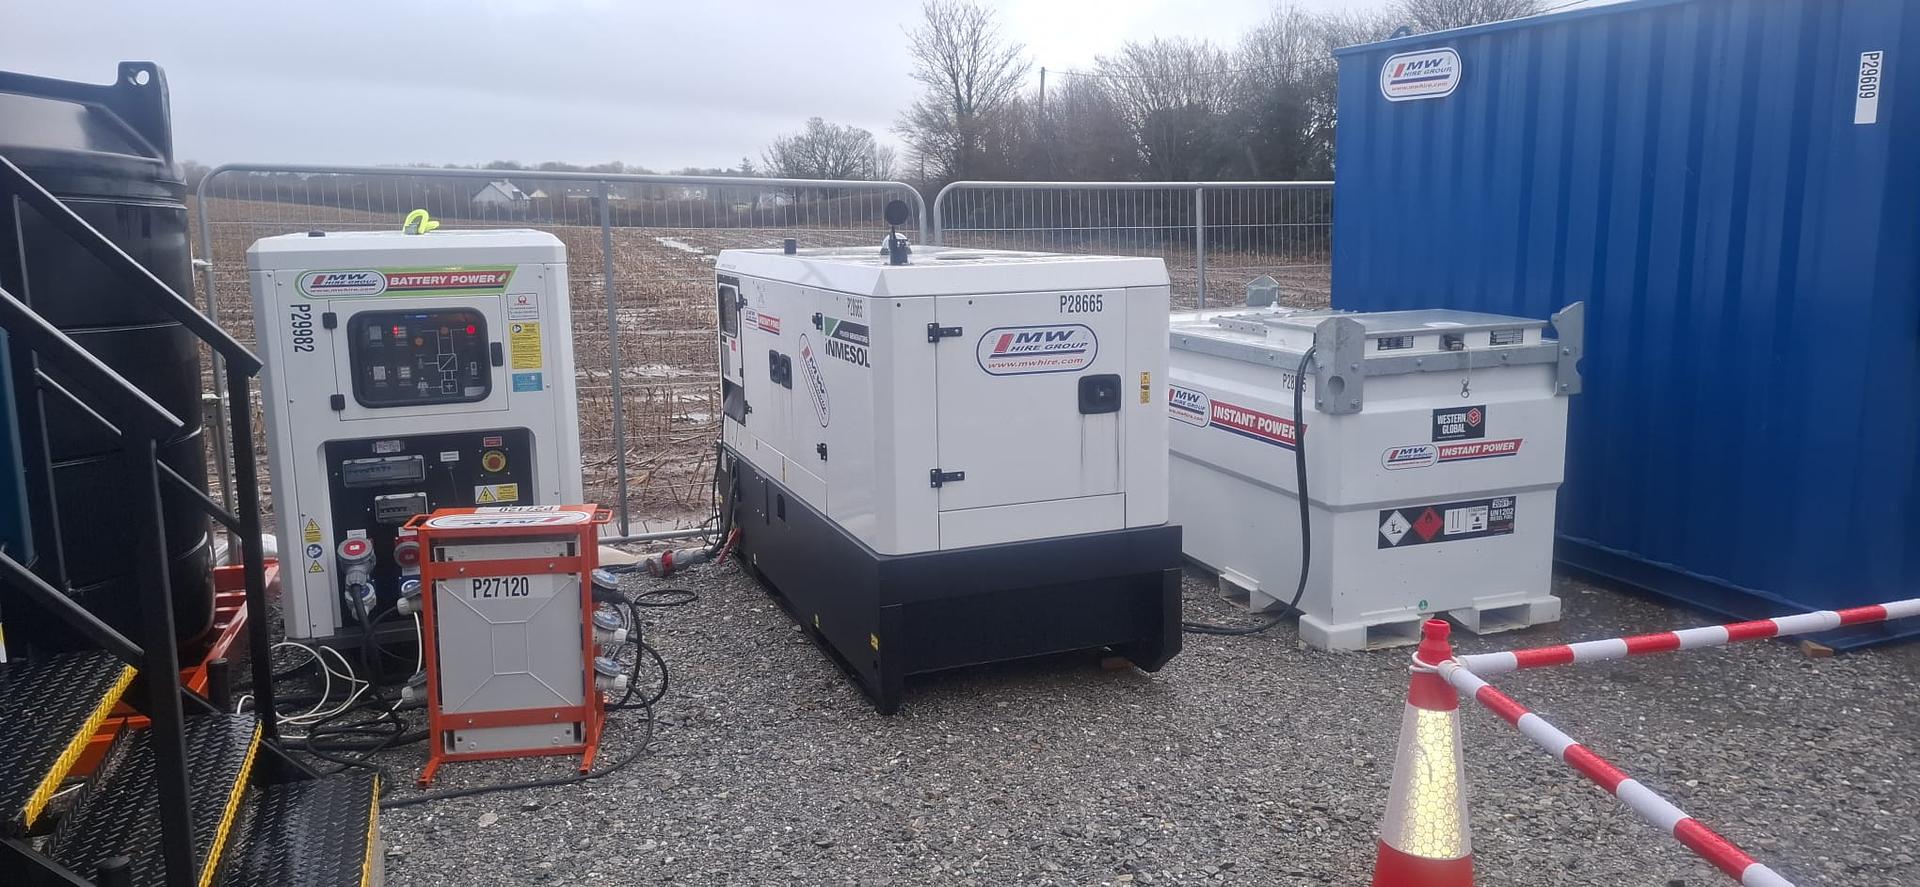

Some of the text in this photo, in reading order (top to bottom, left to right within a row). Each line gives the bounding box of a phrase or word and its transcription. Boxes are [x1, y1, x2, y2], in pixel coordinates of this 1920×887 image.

[1407, 58, 1443, 70] MW
[1859, 53, 1880, 99] P29609
[327, 273, 368, 281] MW
[390, 273, 495, 286] BATTERY POWER
[1059, 294, 1103, 313] P28665
[290, 304, 315, 352] P29982
[1014, 330, 1075, 343] MW
[1010, 342, 1089, 352] HIRE GROUP
[988, 358, 1084, 369] www.mwhire.com
[1175, 390, 1201, 403] MW
[1213, 405, 1296, 439] INSTANT POWER
[1437, 412, 1466, 425] WESTERN
[1442, 423, 1466, 435] GLOBAL
[1400, 447, 1427, 455] MW
[1441, 442, 1515, 456] INSTANT POWER
[472, 577, 529, 598] P27120
